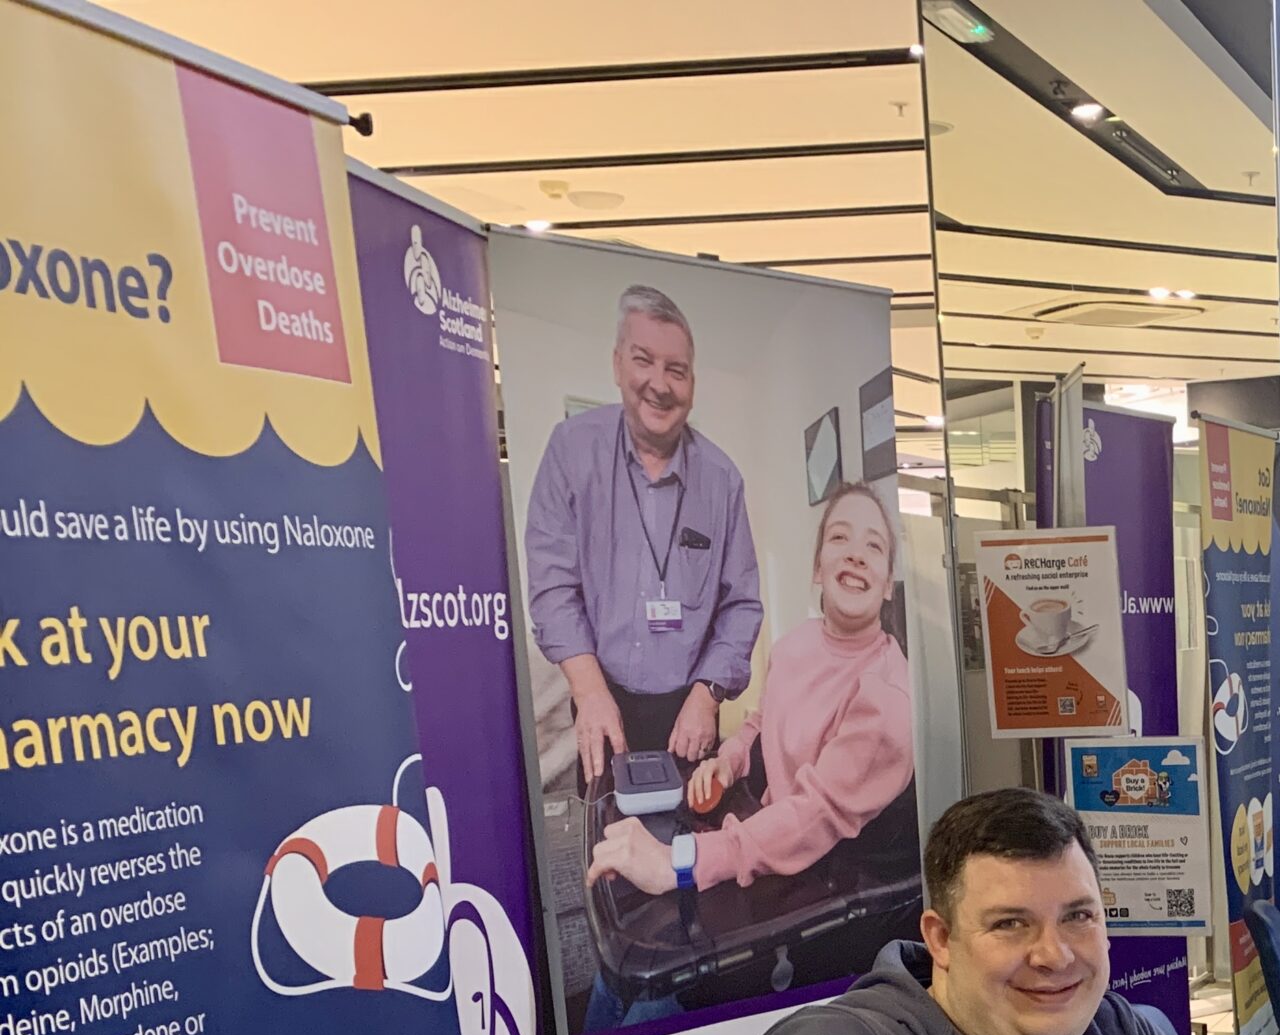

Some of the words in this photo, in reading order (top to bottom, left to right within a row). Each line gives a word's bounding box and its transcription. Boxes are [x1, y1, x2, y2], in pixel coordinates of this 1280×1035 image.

[232, 193, 319, 246] Prevent
[217, 243, 327, 295] Overdose
[257, 299, 335, 346] Deaths
[0, 499, 49, 540] uld
[55, 510, 109, 541] save
[114, 515, 129, 541] a
[132, 506, 171, 544] life
[175, 508, 209, 552] by
[214, 515, 281, 555] using
[283, 514, 377, 550] Naloxone
[1068, 555, 1089, 567] Café
[40, 605, 93, 667] at
[99, 612, 211, 681] your
[213, 696, 312, 746] now
[1125, 777, 1140, 786] Buy
[62, 817, 79, 845] is
[82, 819, 95, 843] a
[98, 802, 205, 842] medication
[1088, 825, 1109, 840] BUY
[1110, 826, 1118, 839] A
[1119, 825, 1149, 839] BRICK
[1, 857, 86, 907] quickly
[90, 851, 167, 887] reverses
[169, 842, 202, 871] the
[41, 909, 66, 943] of
[70, 910, 98, 938] an
[100, 889, 187, 933] overdose
[25, 948, 110, 996] opioids
[111, 925, 216, 977] (Examples;
[79, 977, 180, 1027] Morphine,
